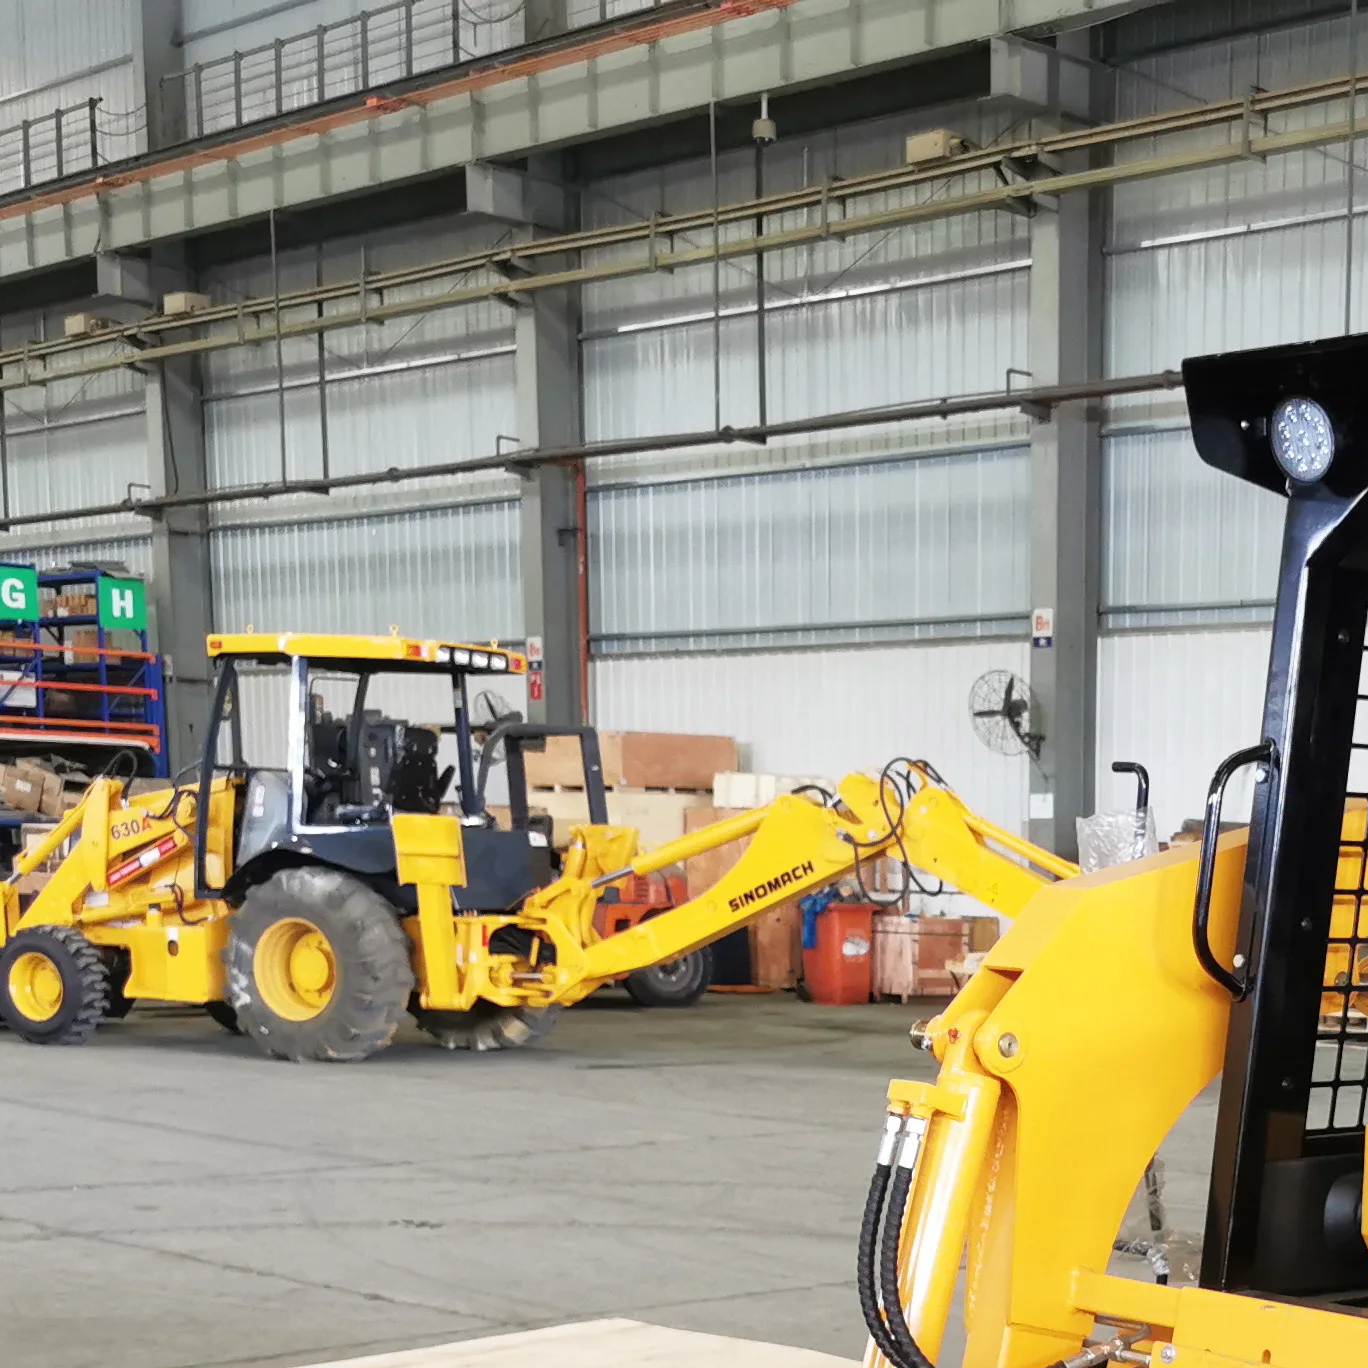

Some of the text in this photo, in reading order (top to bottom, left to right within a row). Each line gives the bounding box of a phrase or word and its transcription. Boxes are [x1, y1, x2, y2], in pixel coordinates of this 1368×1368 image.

[1, 577, 26, 609] G
[111, 588, 134, 619] H
[728, 860, 814, 913] SINOMACH
